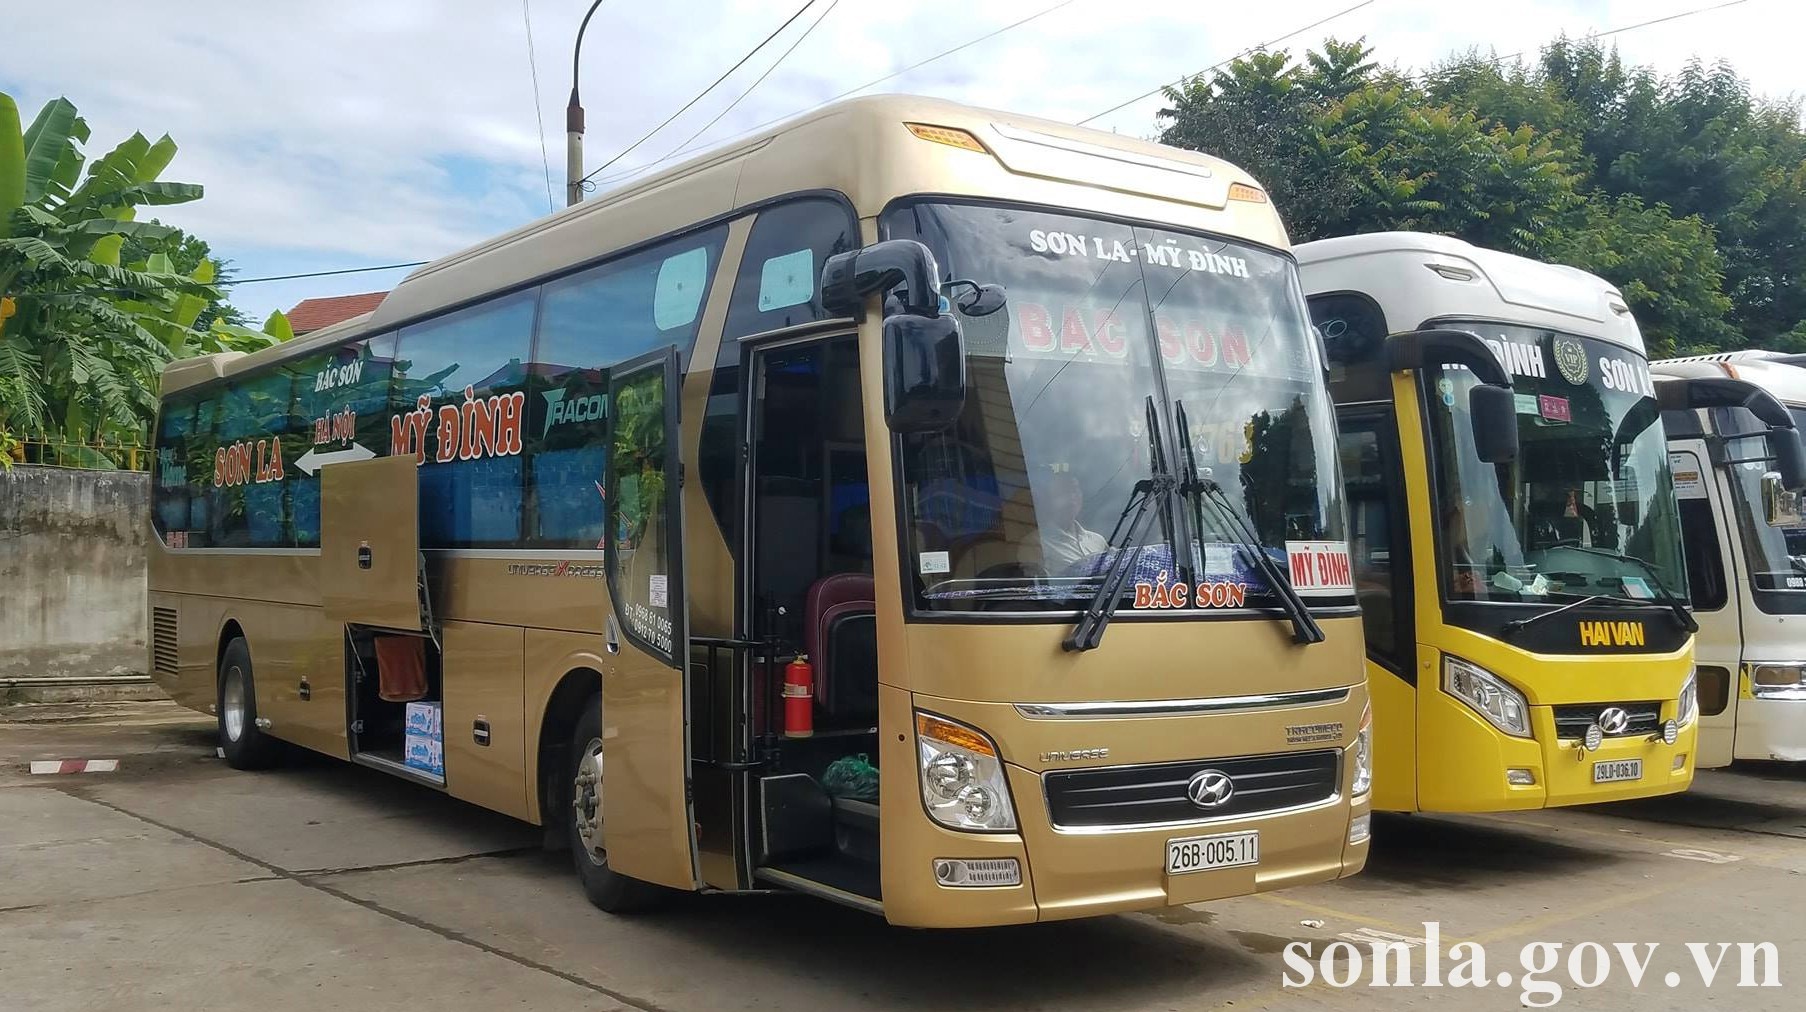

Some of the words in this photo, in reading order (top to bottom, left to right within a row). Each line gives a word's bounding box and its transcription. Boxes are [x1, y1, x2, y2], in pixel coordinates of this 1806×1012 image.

[1030, 229, 1087, 256] SƠN
[1146, 239, 1182, 268] MỸ
[1188, 245, 1250, 279] ĐÌNH
[314, 356, 338, 392] BẮC
[337, 358, 364, 387] SƠN
[1564, 353, 1578, 364] VIP
[1599, 356, 1638, 394] SƠN
[331, 403, 356, 447] NỘI
[391, 393, 433, 466] MỸ
[436, 384, 524, 463] ĐÌNH
[214, 439, 252, 488] SƠN
[256, 435, 284, 484] LA
[1290, 545, 1314, 586] MỸ
[1317, 545, 1351, 586] ĐÌNH
[1133, 570, 1187, 608] BẮC
[1195, 580, 1246, 608] SƠN
[1039, 748, 1110, 763] UNIVERSE
